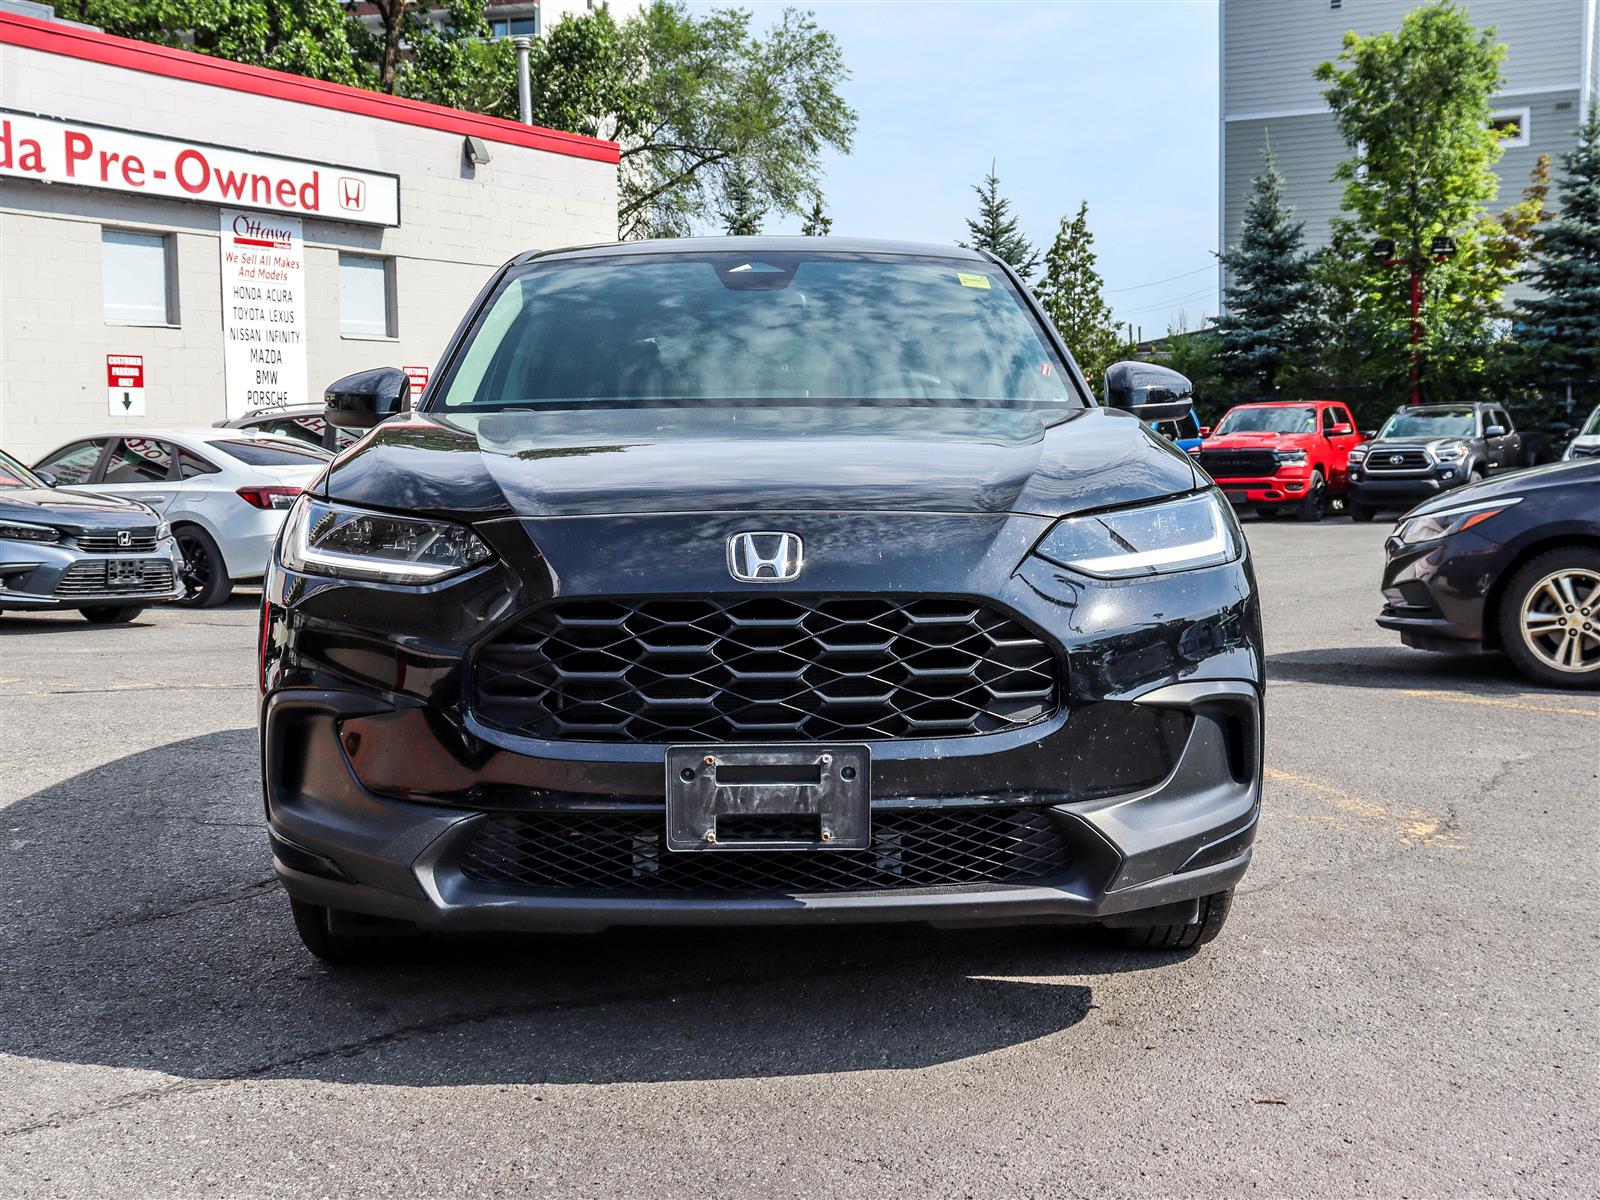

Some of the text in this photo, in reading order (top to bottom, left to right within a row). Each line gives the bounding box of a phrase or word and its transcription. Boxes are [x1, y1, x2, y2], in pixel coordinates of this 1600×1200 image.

[64, 130, 319, 211] Pre-Owned
[232, 214, 291, 241] Ottawa
[226, 251, 300, 269] We Sell All Makes
[238, 266, 288, 281] And Models
[233, 285, 293, 303] HONDA ACURA
[233, 306, 295, 323] TOYOTA LEXUS
[230, 327, 300, 344] NISSAN INFINITY
[250, 348, 283, 364] MAZDA
[256, 369, 278, 385] BMW
[247, 390, 288, 406] PORSCHE
